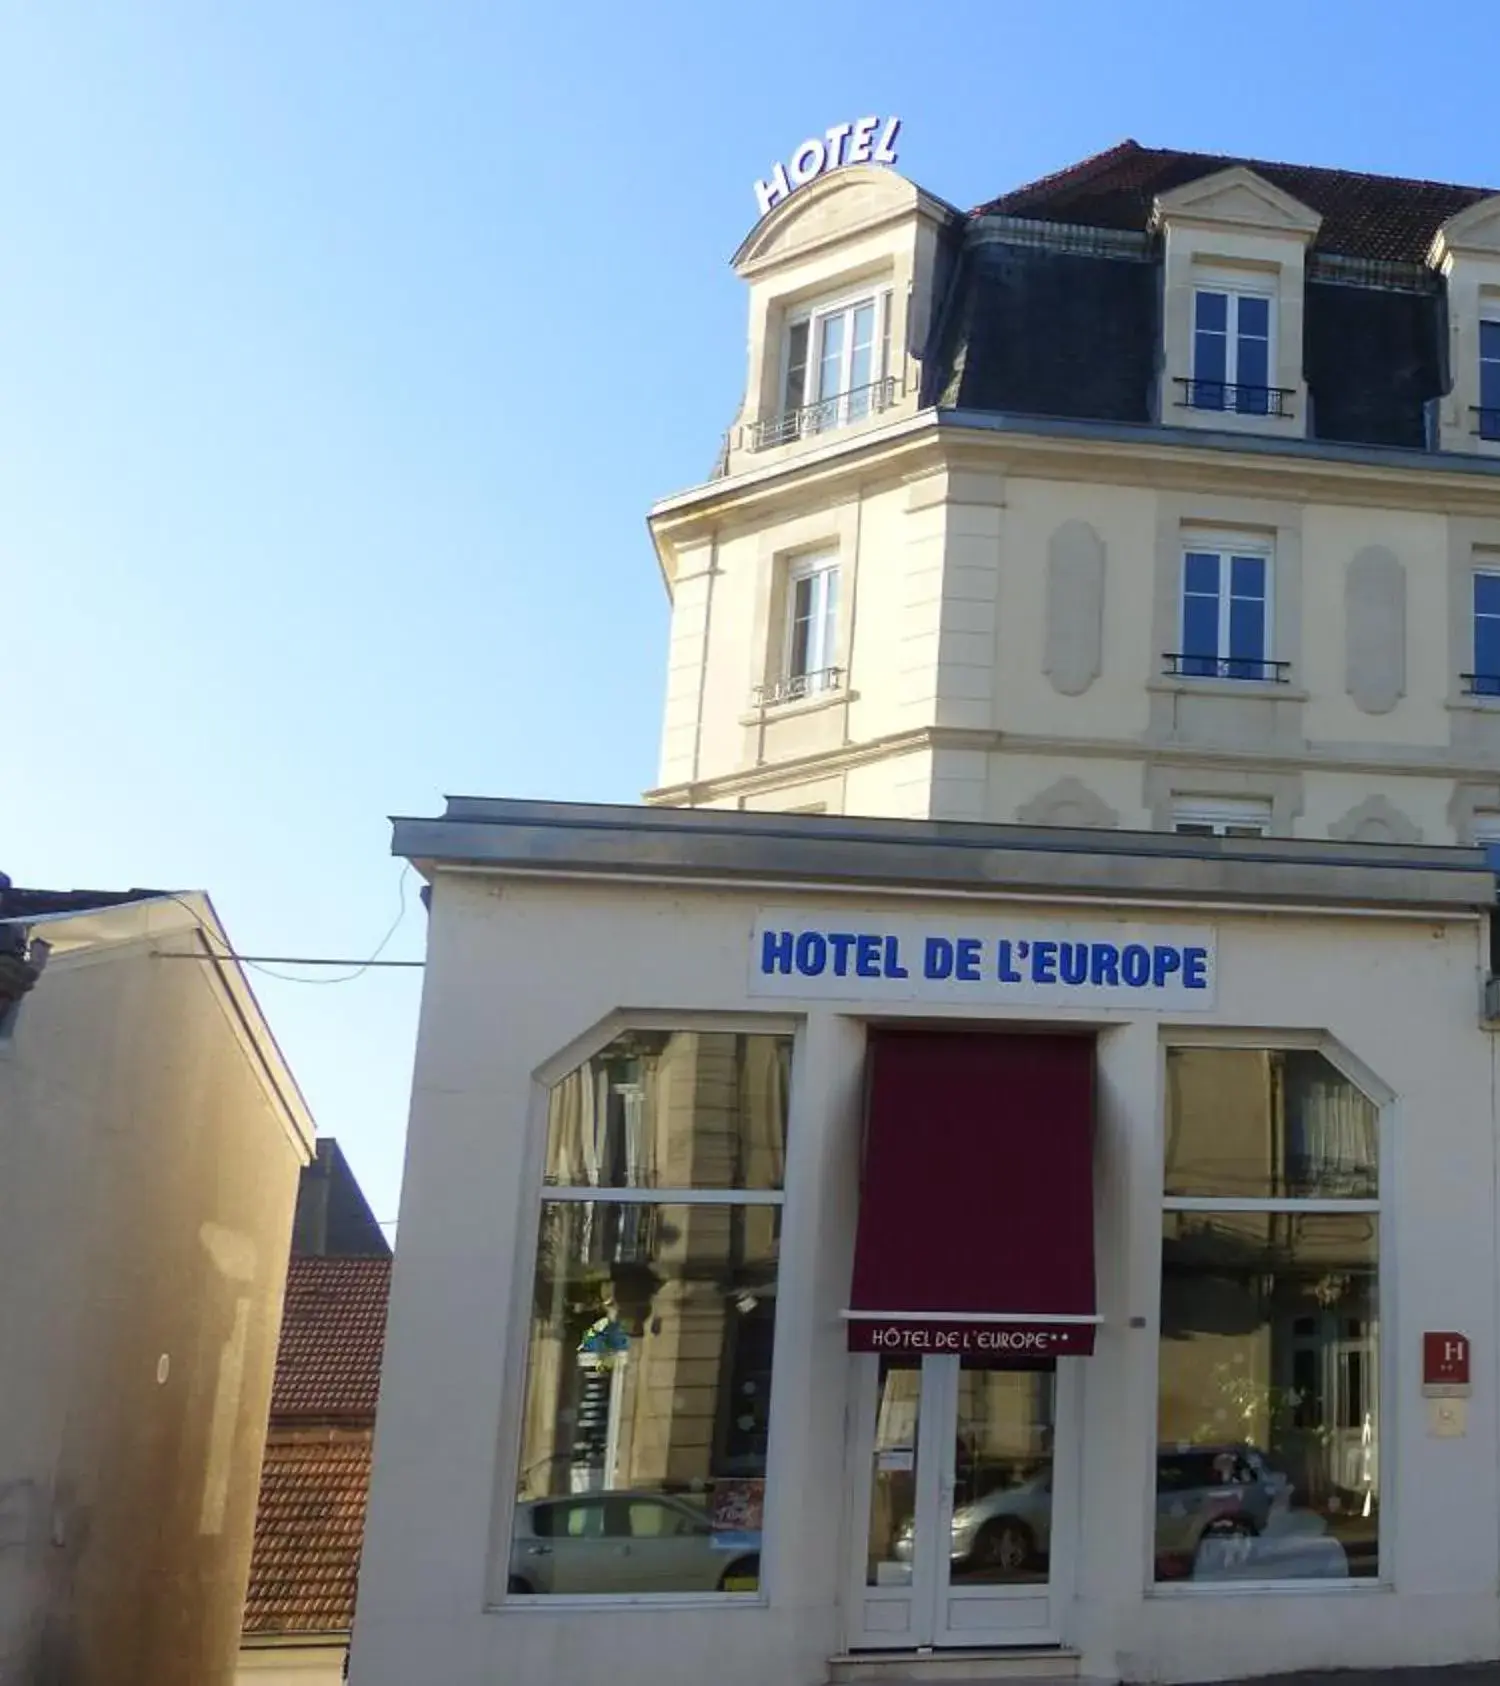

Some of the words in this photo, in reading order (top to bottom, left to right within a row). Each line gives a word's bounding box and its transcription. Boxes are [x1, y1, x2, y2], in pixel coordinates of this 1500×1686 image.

[753, 115, 901, 216] HOTEL
[761, 931, 908, 979] HOTEL
[925, 937, 982, 981] DE
[997, 939, 1207, 989] L'EUROPE
[871, 1327, 931, 1348] HÔTEL
[935, 1331, 960, 1349] DE
[963, 1330, 1048, 1349] L'EUROPE
[1445, 1341, 1463, 1361] H
